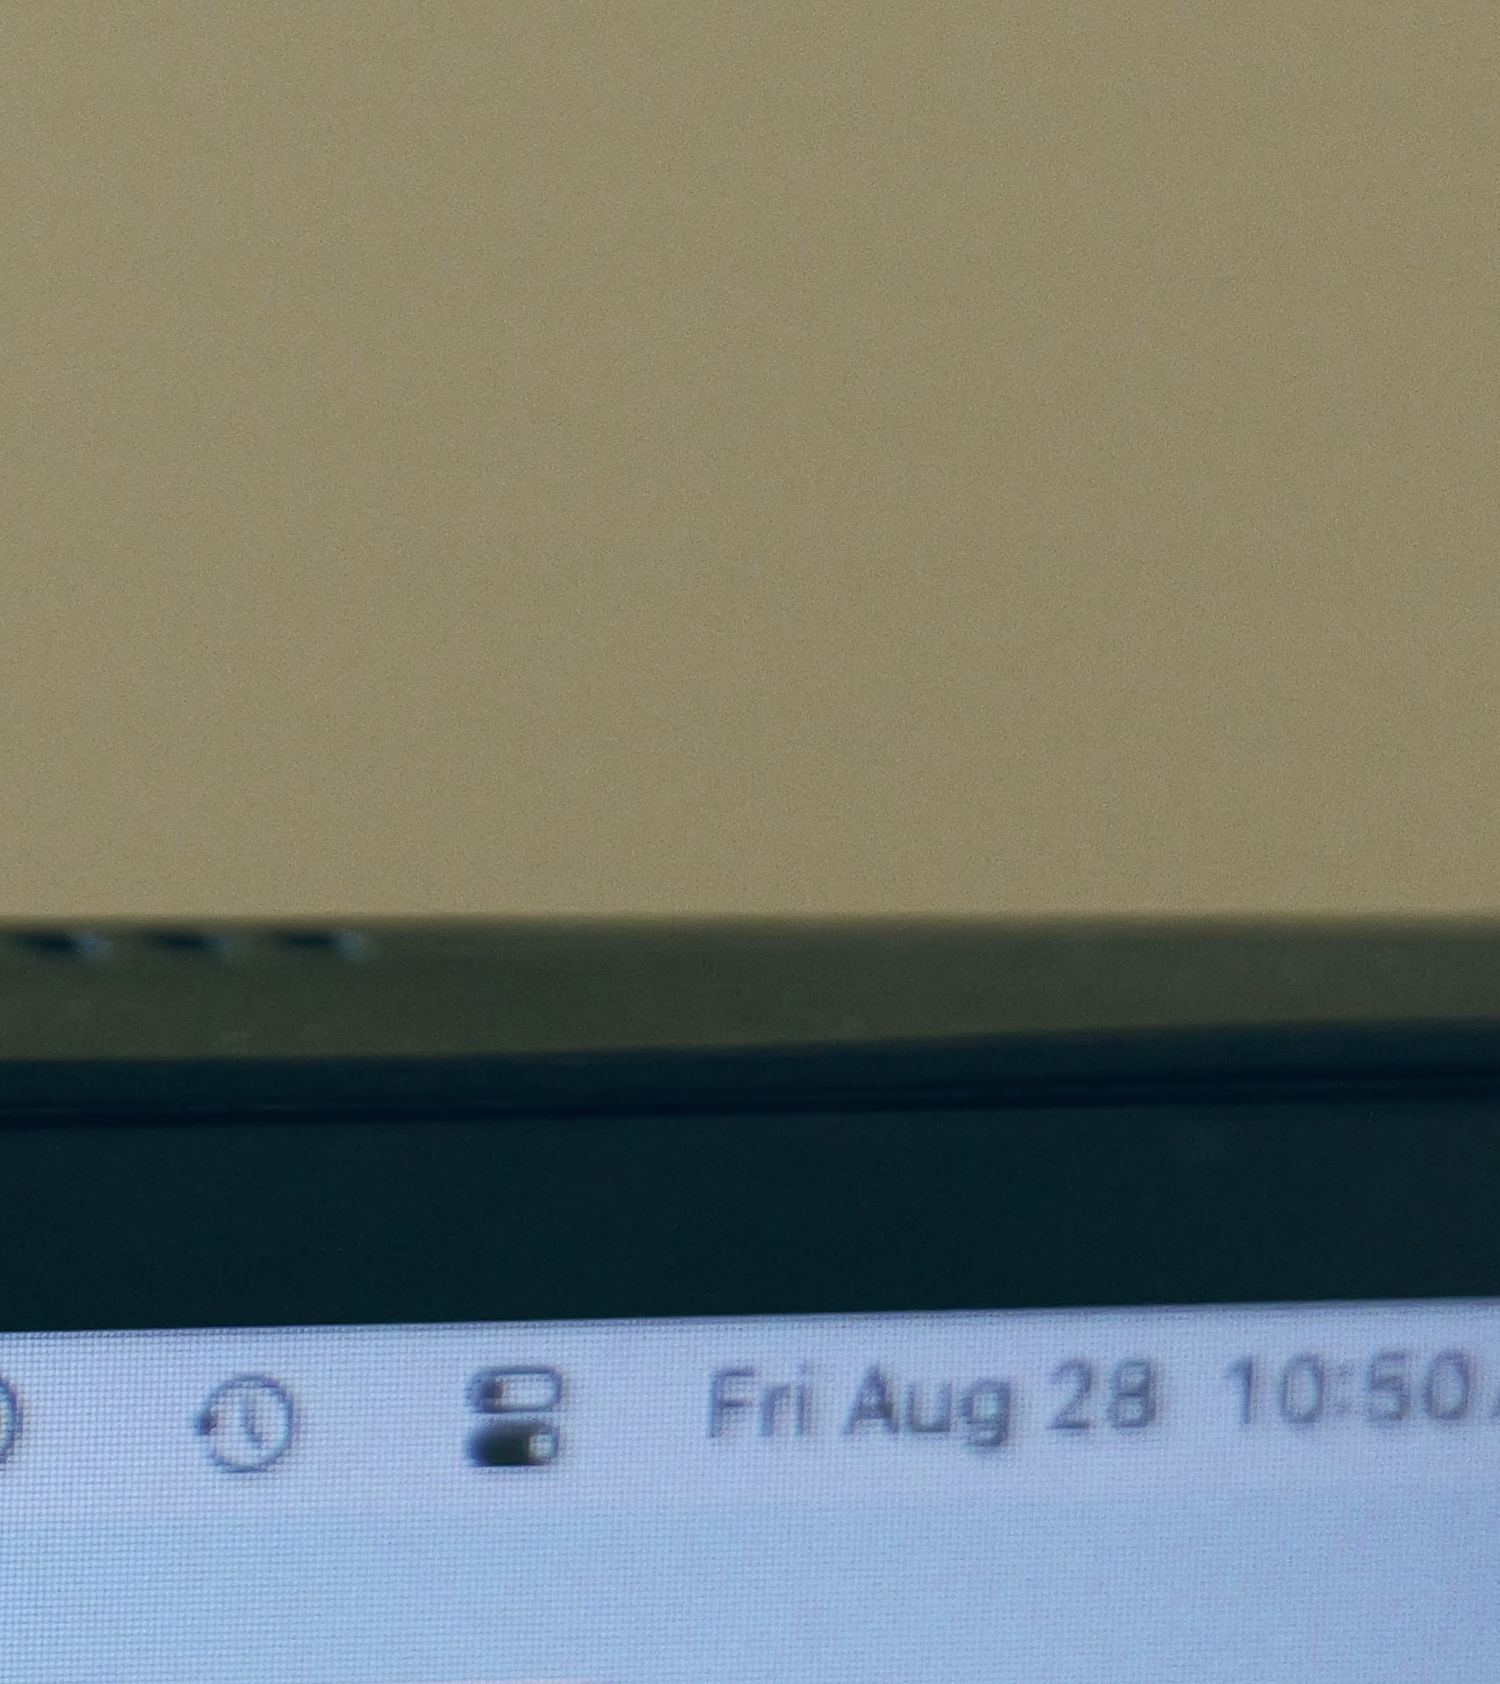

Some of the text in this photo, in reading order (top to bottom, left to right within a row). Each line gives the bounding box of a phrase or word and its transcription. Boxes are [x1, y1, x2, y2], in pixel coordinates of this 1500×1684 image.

[708, 1361, 810, 1438] Fri
[843, 1363, 1013, 1451] Aug
[1049, 1358, 1161, 1432] 28
[1225, 1350, 1474, 1424] 10:50
